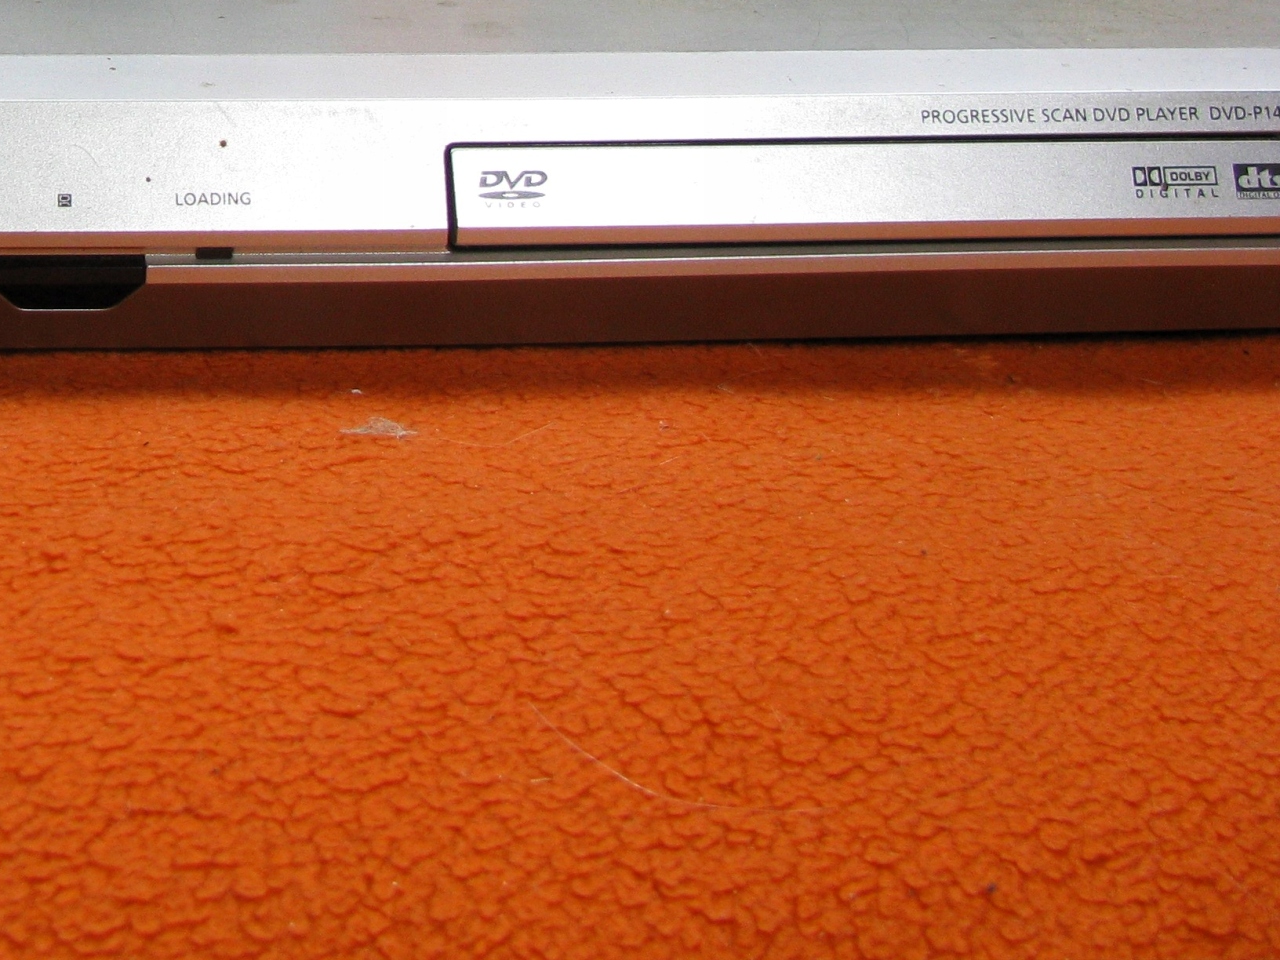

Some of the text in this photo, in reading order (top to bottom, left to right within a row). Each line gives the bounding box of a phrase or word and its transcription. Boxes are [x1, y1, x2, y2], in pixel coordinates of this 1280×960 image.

[921, 107, 1036, 124] PROGRESSIVE
[1041, 107, 1087, 123] SCAN
[1092, 106, 1130, 122] DVD
[1136, 105, 1200, 121] PLAYER
[479, 170, 548, 190] DVD
[1170, 171, 1210, 181] DOLBY
[175, 192, 252, 207] LOADING
[1135, 188, 1220, 199] DIGITAL
